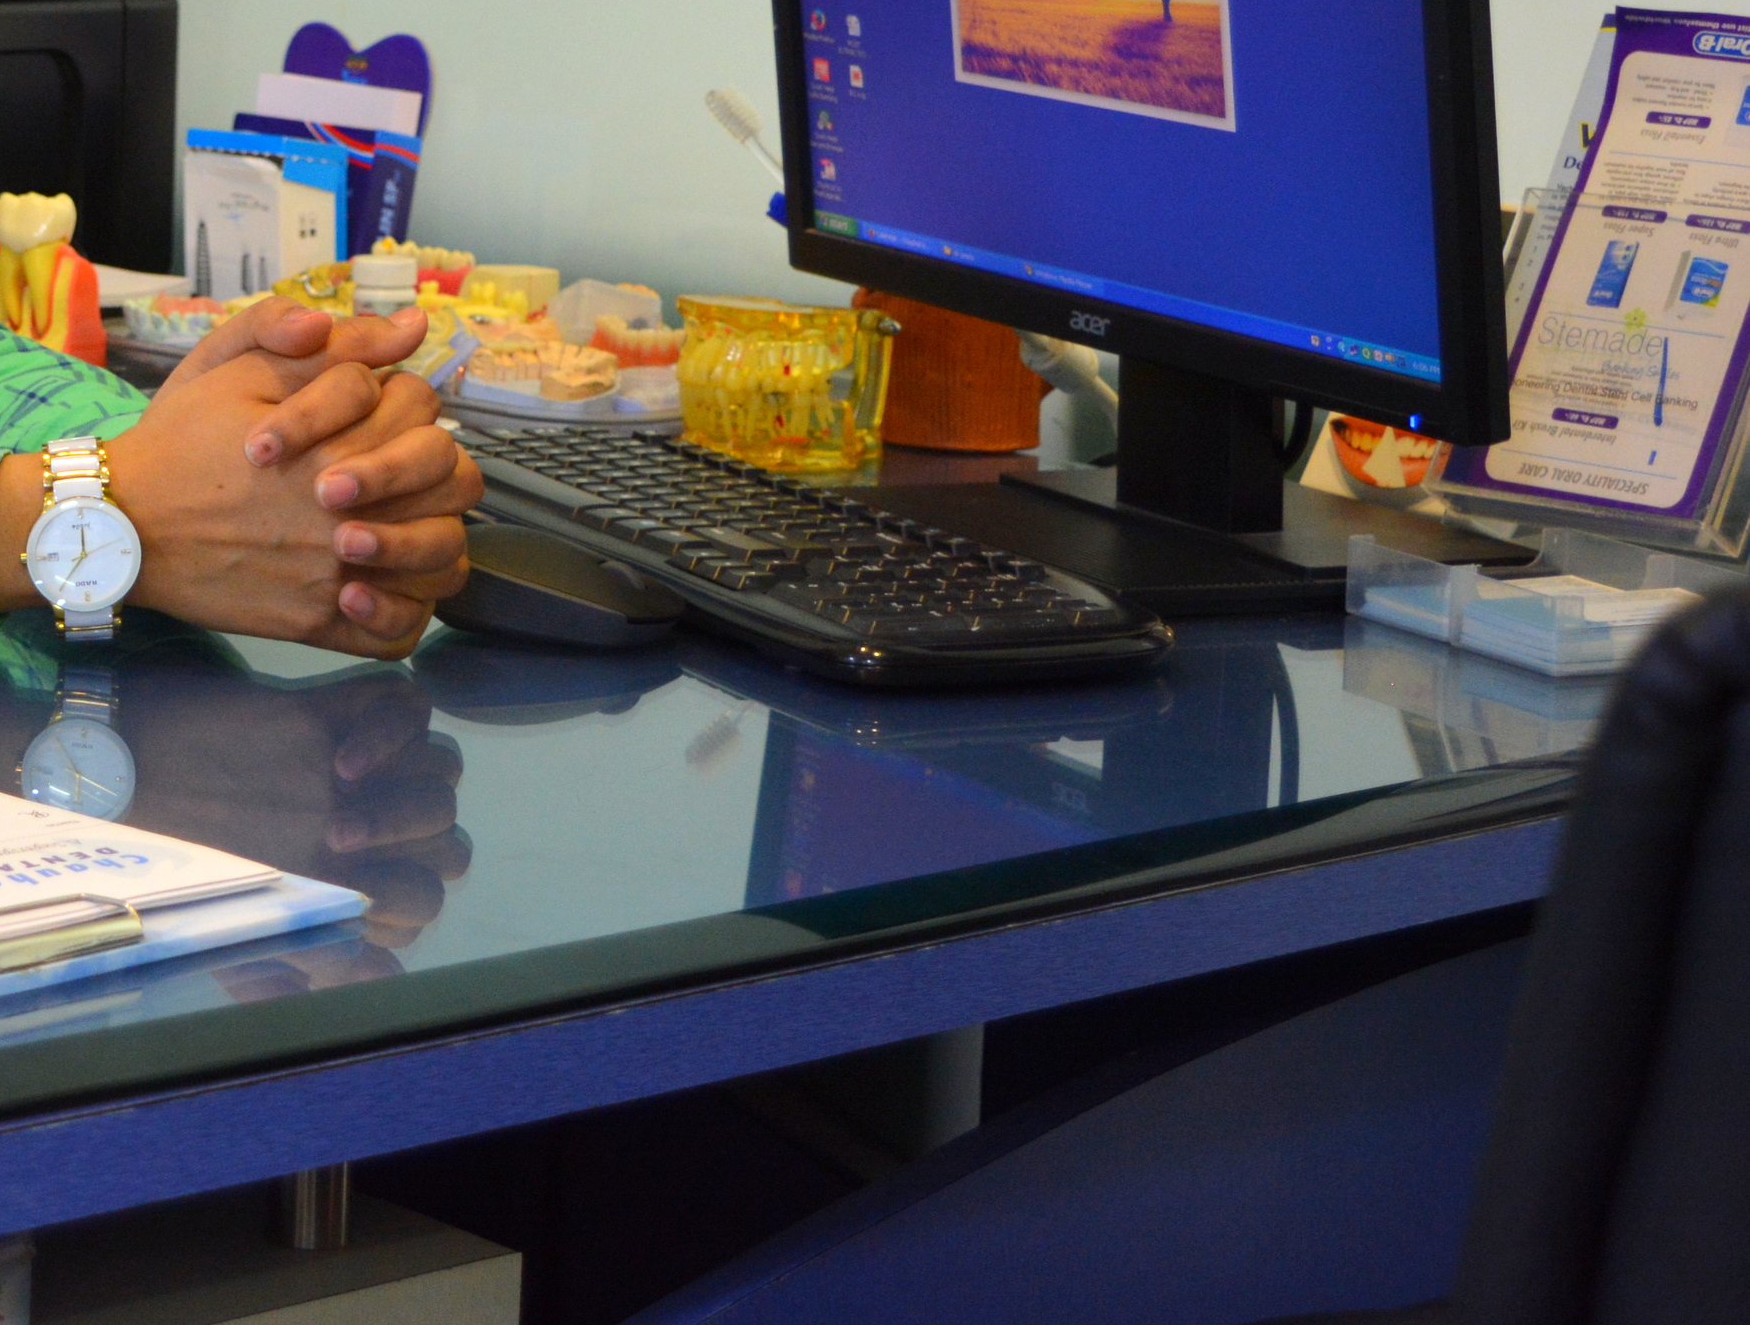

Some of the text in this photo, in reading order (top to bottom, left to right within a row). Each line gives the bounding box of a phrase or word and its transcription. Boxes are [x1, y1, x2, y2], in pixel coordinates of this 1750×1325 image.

[1689, 232, 1740, 249] Ultra Floss
[1069, 310, 1111, 336] acer
[1538, 316, 1663, 357] Stemade
[1514, 377, 1560, 394] oneering
[1563, 383, 1598, 396] Dental
[1631, 391, 1653, 404] Cell
[1530, 423, 1557, 436] Brush
[1559, 428, 1617, 446] Interdental
[1518, 463, 1650, 495] SPECIALITY ORAL CARE
